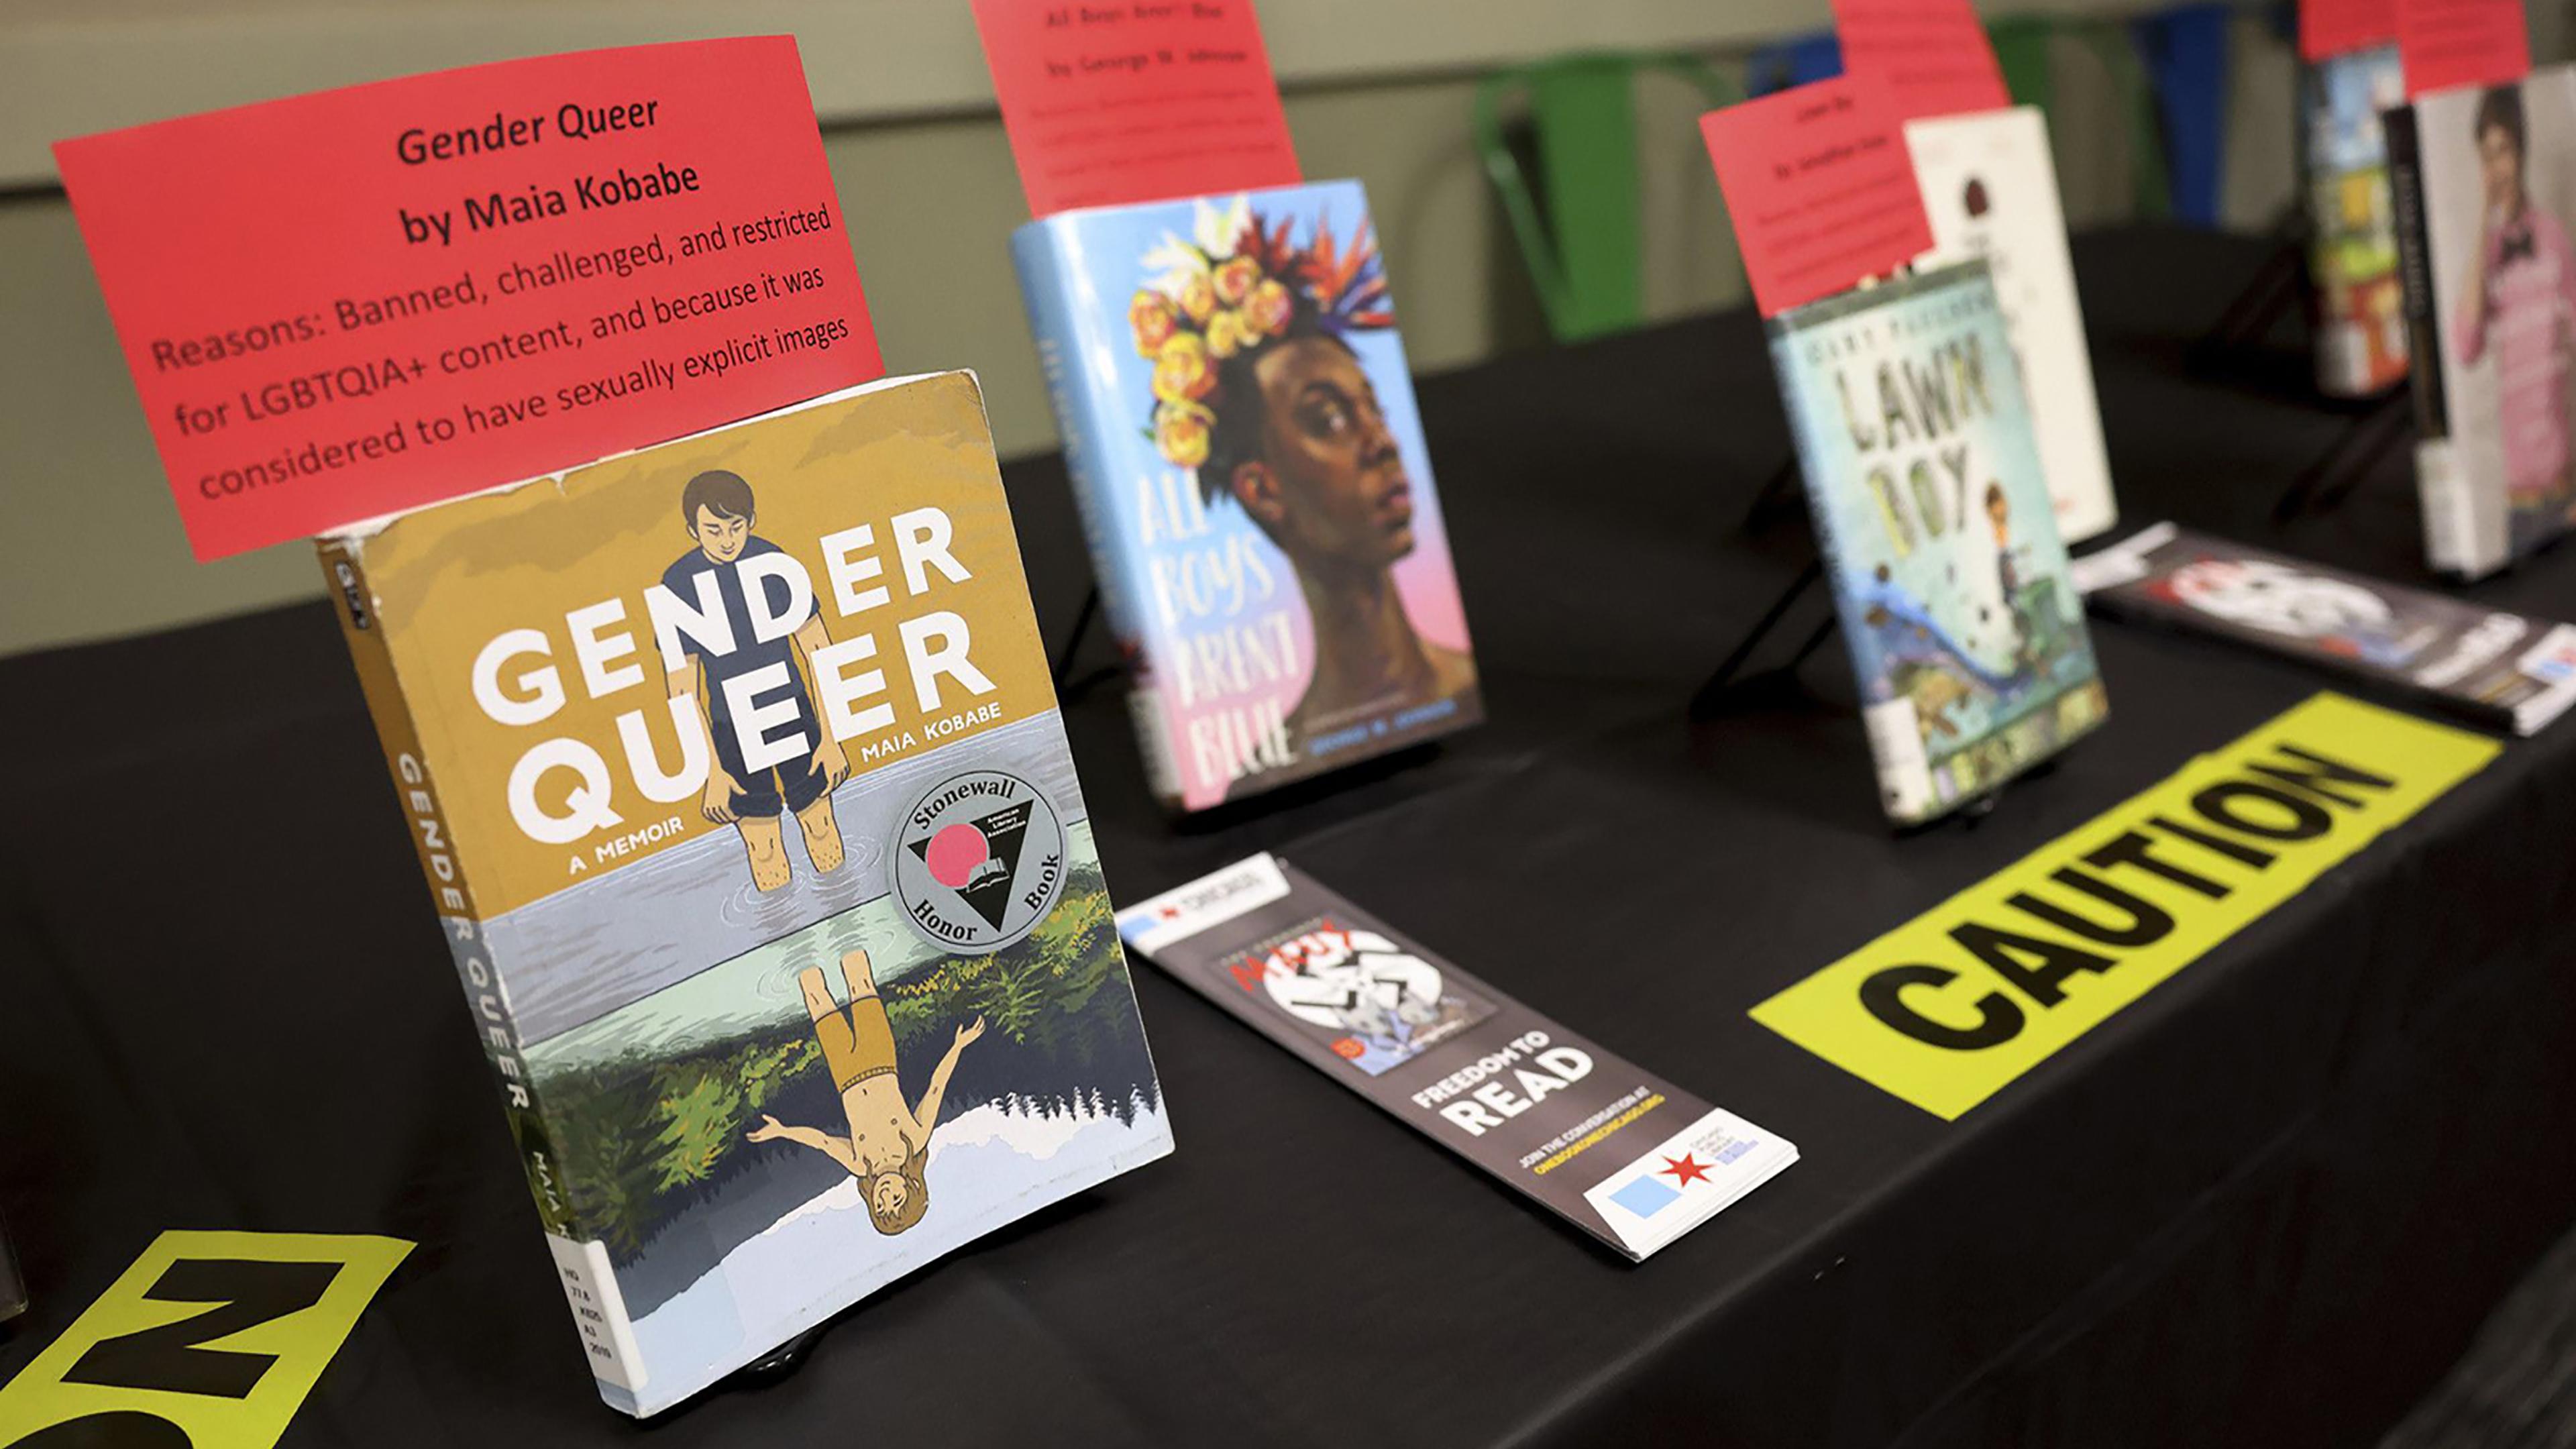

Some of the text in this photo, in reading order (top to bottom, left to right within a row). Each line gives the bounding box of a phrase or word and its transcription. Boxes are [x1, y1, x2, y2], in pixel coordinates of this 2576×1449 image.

[398, 99, 659, 166] Gender Queer
[399, 162, 700, 246] by Maia Kobabe
[150, 202, 832, 373] Reasons: Banned, challenged, and restricted
[173, 265, 825, 437] for LGBTQIA+ content, and because it was
[1835, 331, 1995, 452] LAWN
[199, 315, 849, 501] considered to have sexually explicit images
[1136, 468, 1214, 547] ALL
[471, 506, 973, 726] GENDER
[1150, 530, 1275, 627] BOYS
[506, 610, 998, 844] QUEER
[861, 701, 1002, 763] MAIA KOBABE
[569, 816, 685, 875] A MEMOIR
[913, 778, 1017, 830] Stonewall
[987, 808, 1020, 824] American
[987, 820, 1026, 838] Association
[993, 816, 1017, 829] Library
[398, 752, 530, 1109] GENDER QUEER
[913, 854, 1059, 941] Honor Book
[1858, 742, 2400, 1053] CAUTION
[1411, 1046, 1521, 1110] FREEDOM
[1509, 1030, 1550, 1055] TO
[1439, 1046, 1594, 1138] READ
[533, 1150, 562, 1213] MAIA
[1519, 1149, 1546, 1169] JOIN
[1541, 1136, 1567, 1153] THE
